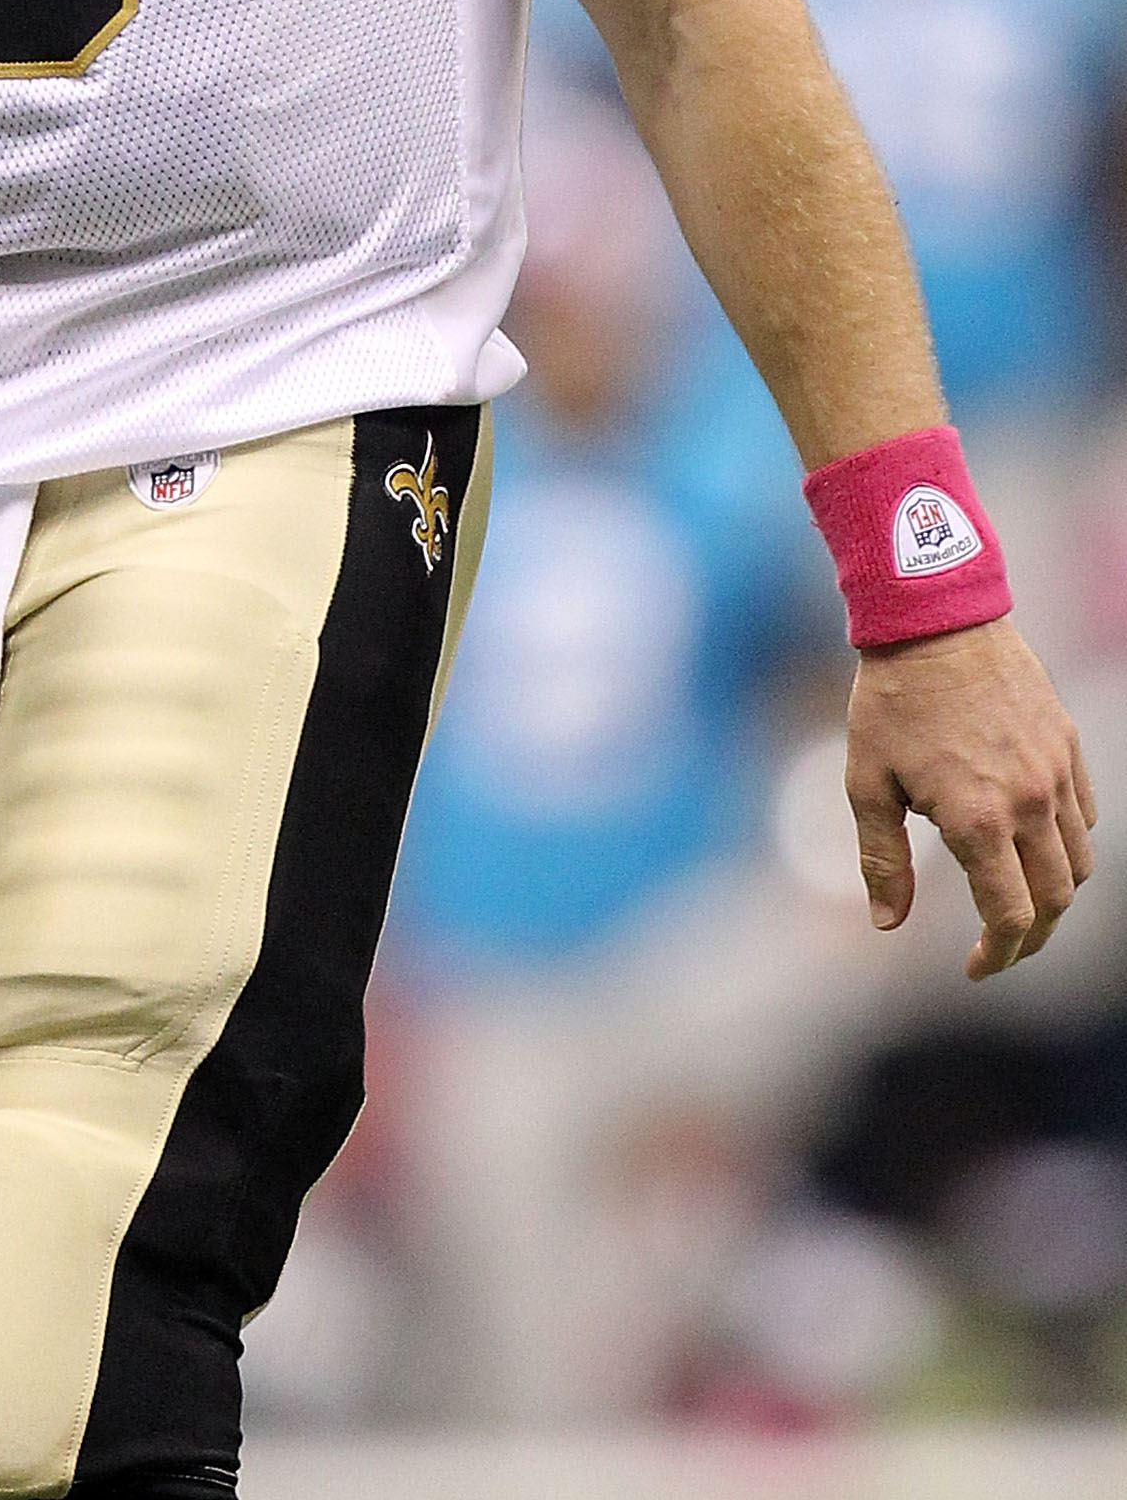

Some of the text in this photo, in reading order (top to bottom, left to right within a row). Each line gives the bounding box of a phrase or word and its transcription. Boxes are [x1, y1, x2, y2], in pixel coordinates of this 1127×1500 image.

[156, 480, 190, 498] NFL
[910, 503, 945, 530] NFL
[906, 536, 972, 567] EQUIPMENT
